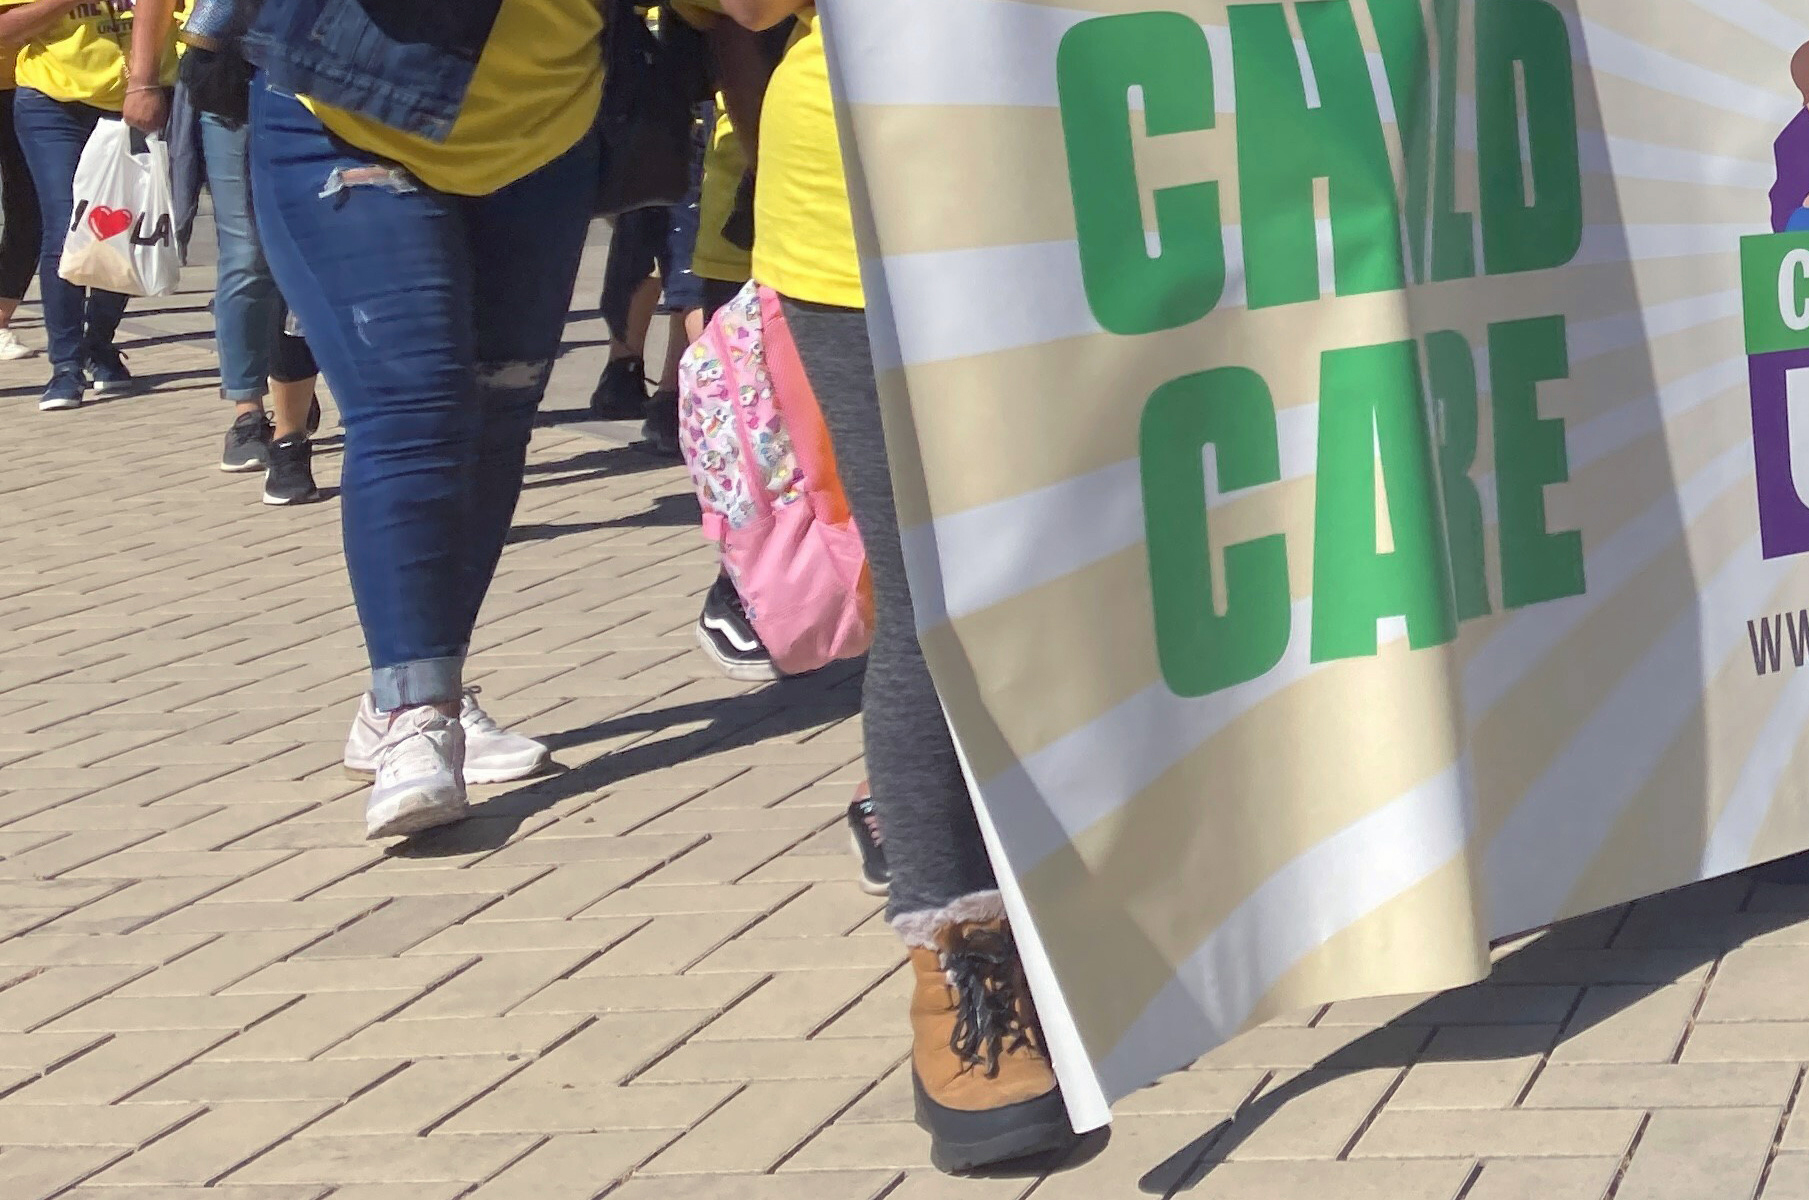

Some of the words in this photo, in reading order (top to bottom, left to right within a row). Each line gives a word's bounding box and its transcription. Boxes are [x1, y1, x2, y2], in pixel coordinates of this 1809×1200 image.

[71, 199, 89, 232] I
[129, 211, 170, 247] LA
[1139, 314, 1586, 698] CARE
